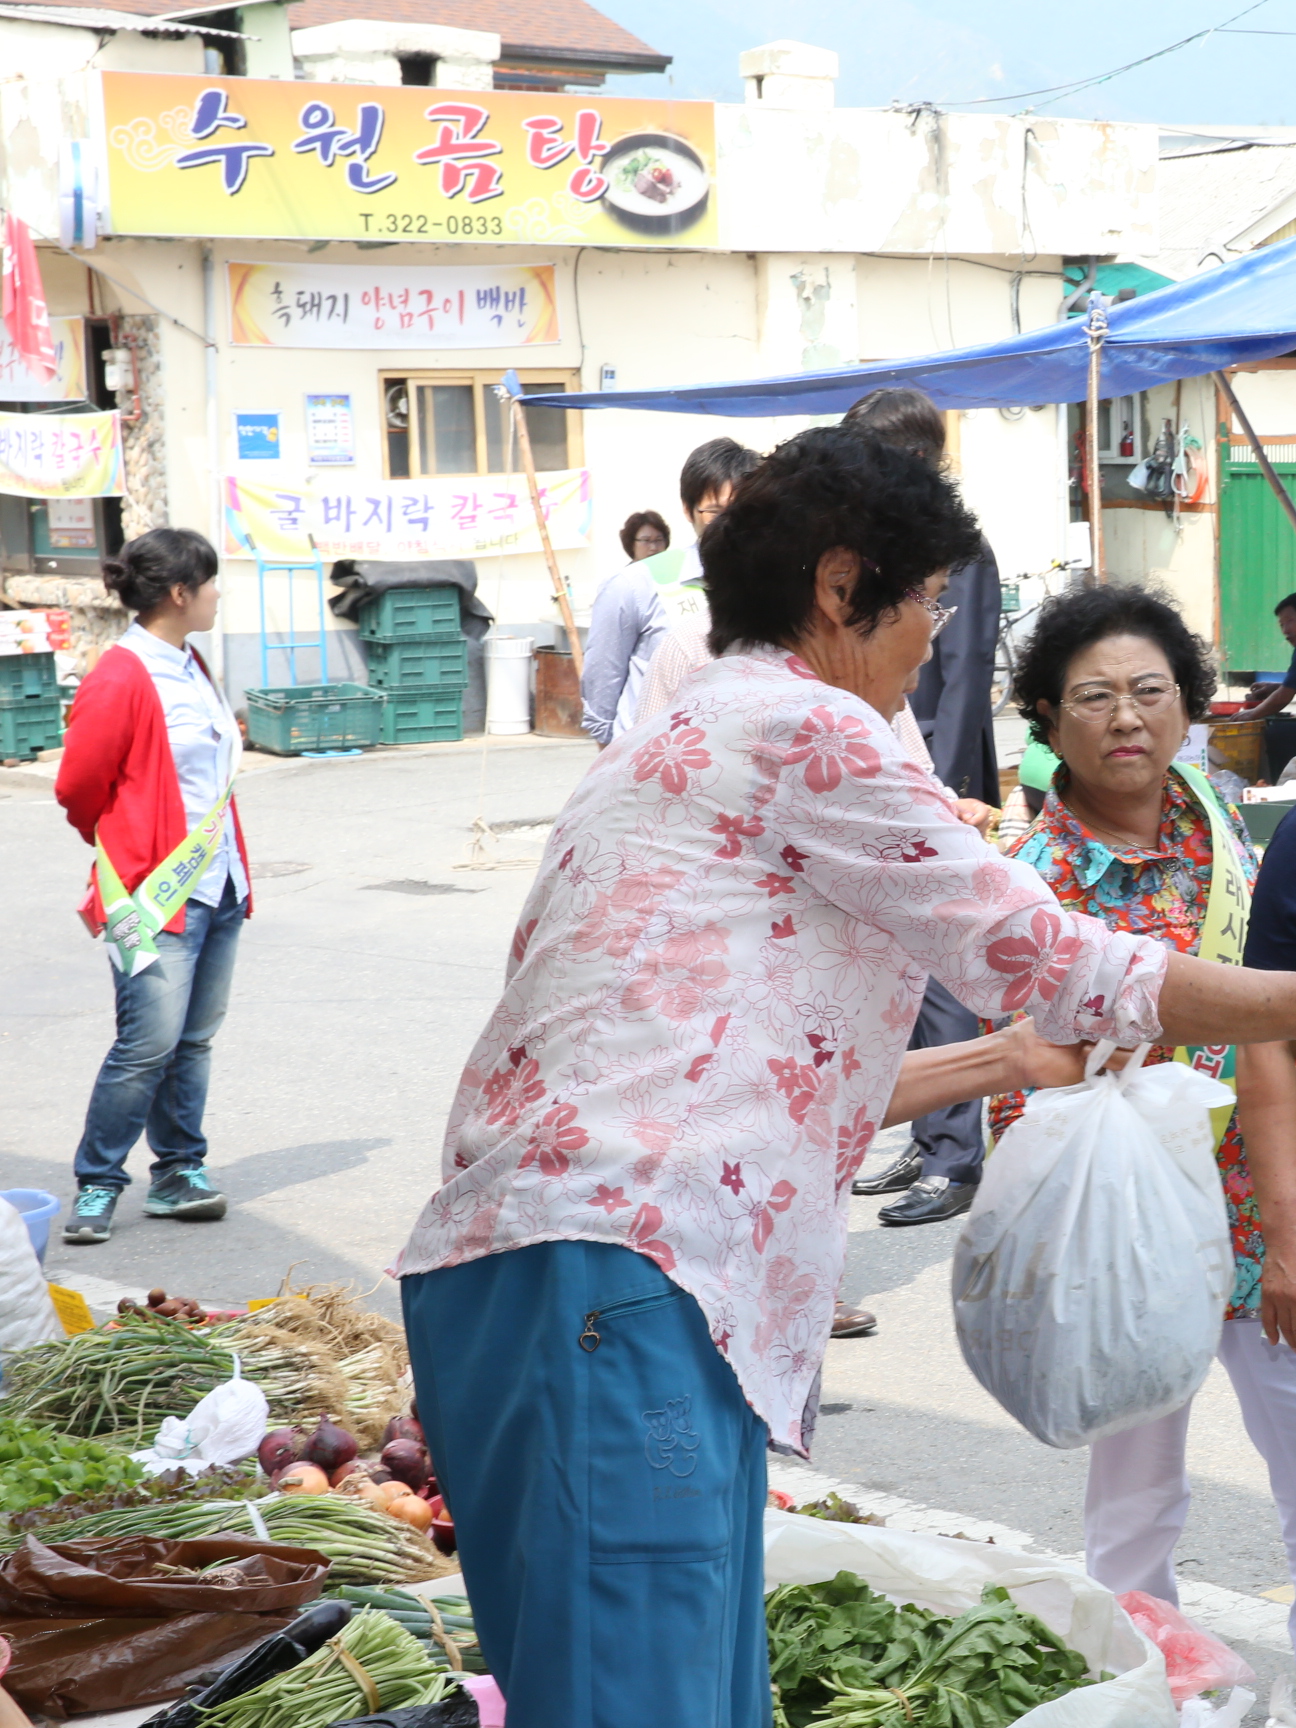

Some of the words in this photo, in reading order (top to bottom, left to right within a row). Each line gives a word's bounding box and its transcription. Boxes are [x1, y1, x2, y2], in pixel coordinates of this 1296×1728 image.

[359, 212, 503, 236] T.322-0833
[271, 281, 350, 328] 흑돼지
[361, 285, 465, 331] 양념구이
[475, 285, 528, 328] 백반
[51, 428, 103, 470] 칼국수
[270, 493, 306, 532] 굴
[321, 494, 435, 534] 바지락
[153, 843, 208, 907] 캠페인
